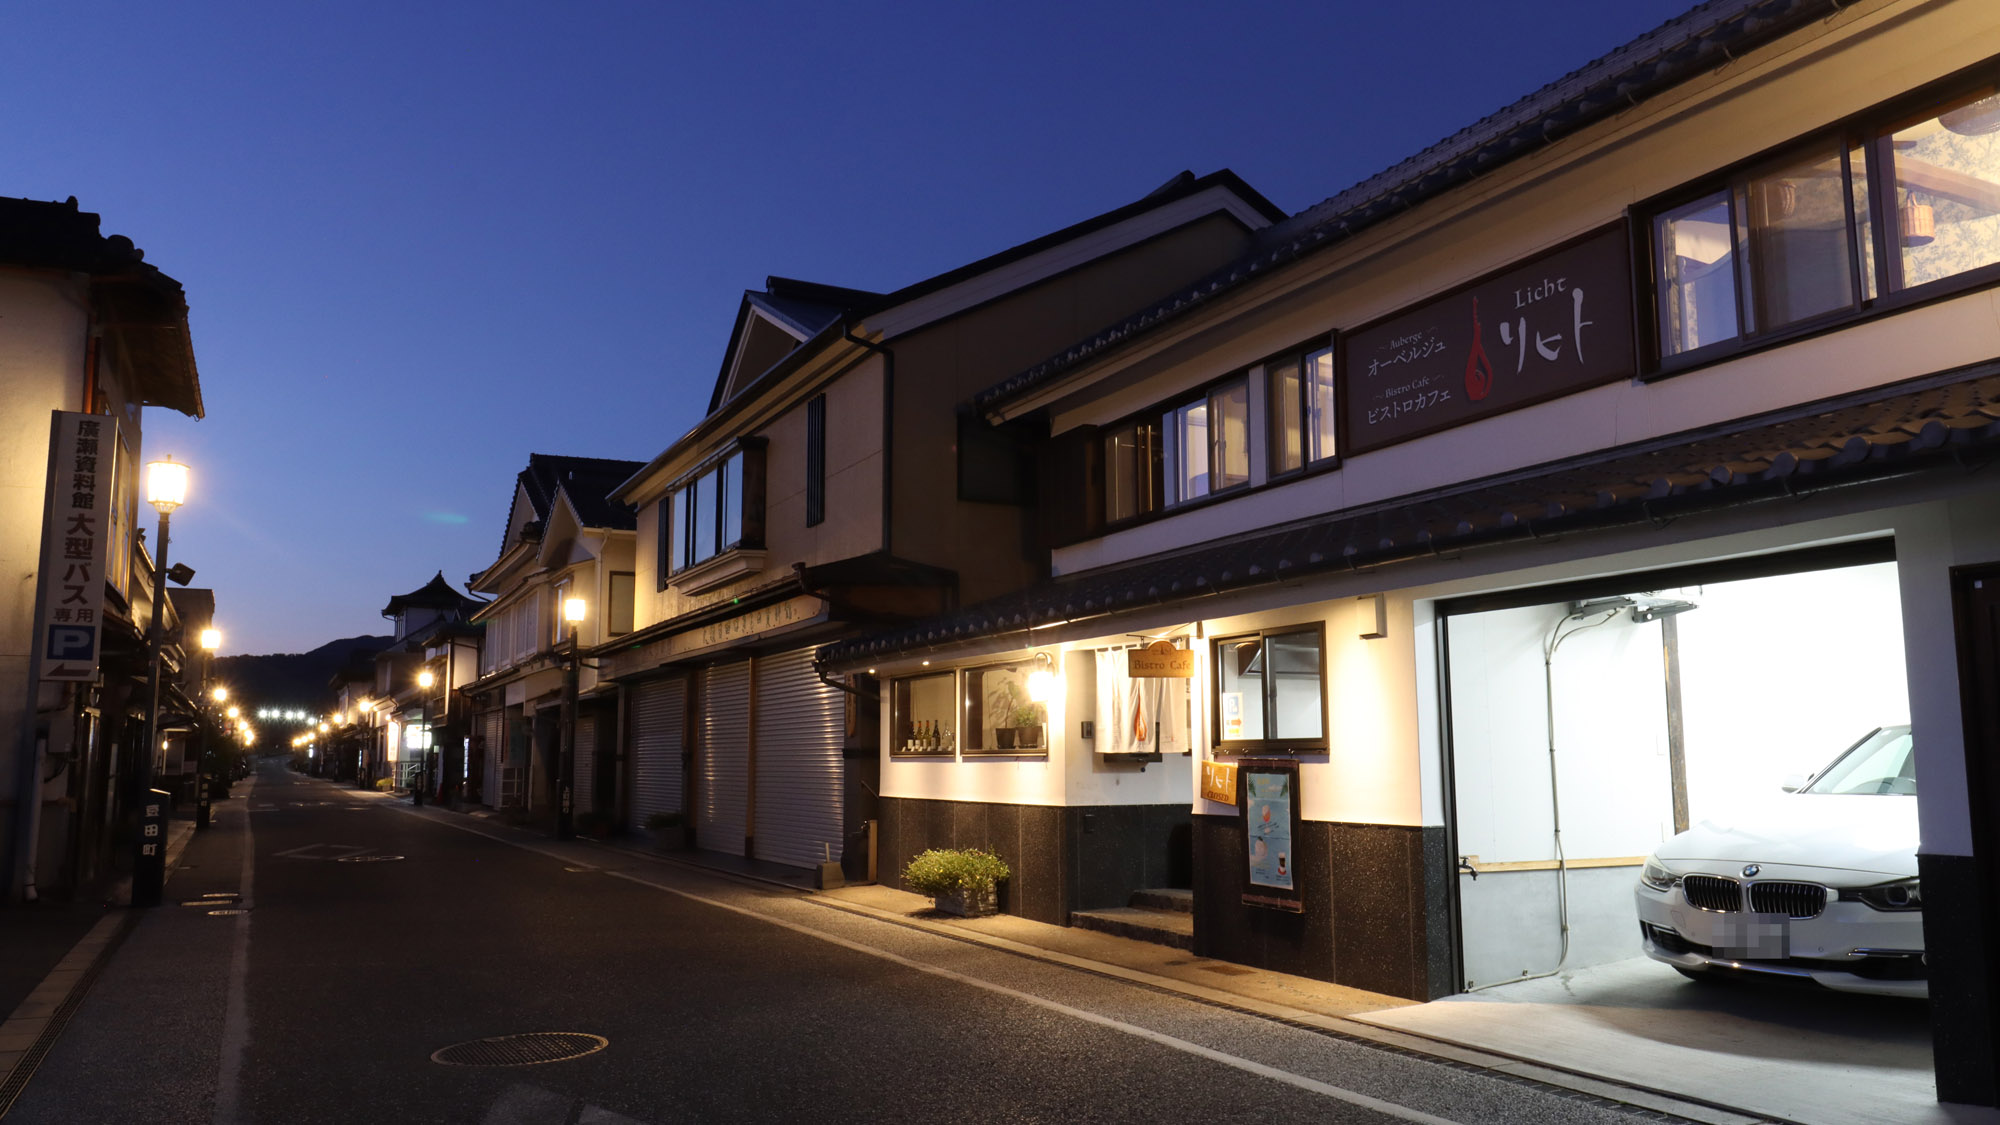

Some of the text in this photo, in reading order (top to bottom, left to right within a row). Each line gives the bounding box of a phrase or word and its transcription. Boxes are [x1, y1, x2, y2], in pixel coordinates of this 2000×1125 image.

[1514, 276, 1568, 310] Licht
[1389, 329, 1424, 351] Auberge
[1499, 287, 1594, 376] リヒト
[1367, 336, 1447, 378] オーベルジュ
[1385, 375, 1431, 399] Bistro Cafe
[1367, 388, 1452, 425] ビストロカフェ
[61, 513, 96, 606] 大型バス
[52, 606, 95, 624] 専用
[51, 629, 91, 657] P
[1134, 660, 1191, 670] Bistro Cafe
[1206, 765, 1233, 795] リヒト
[1207, 790, 1229, 801] CLOSED
